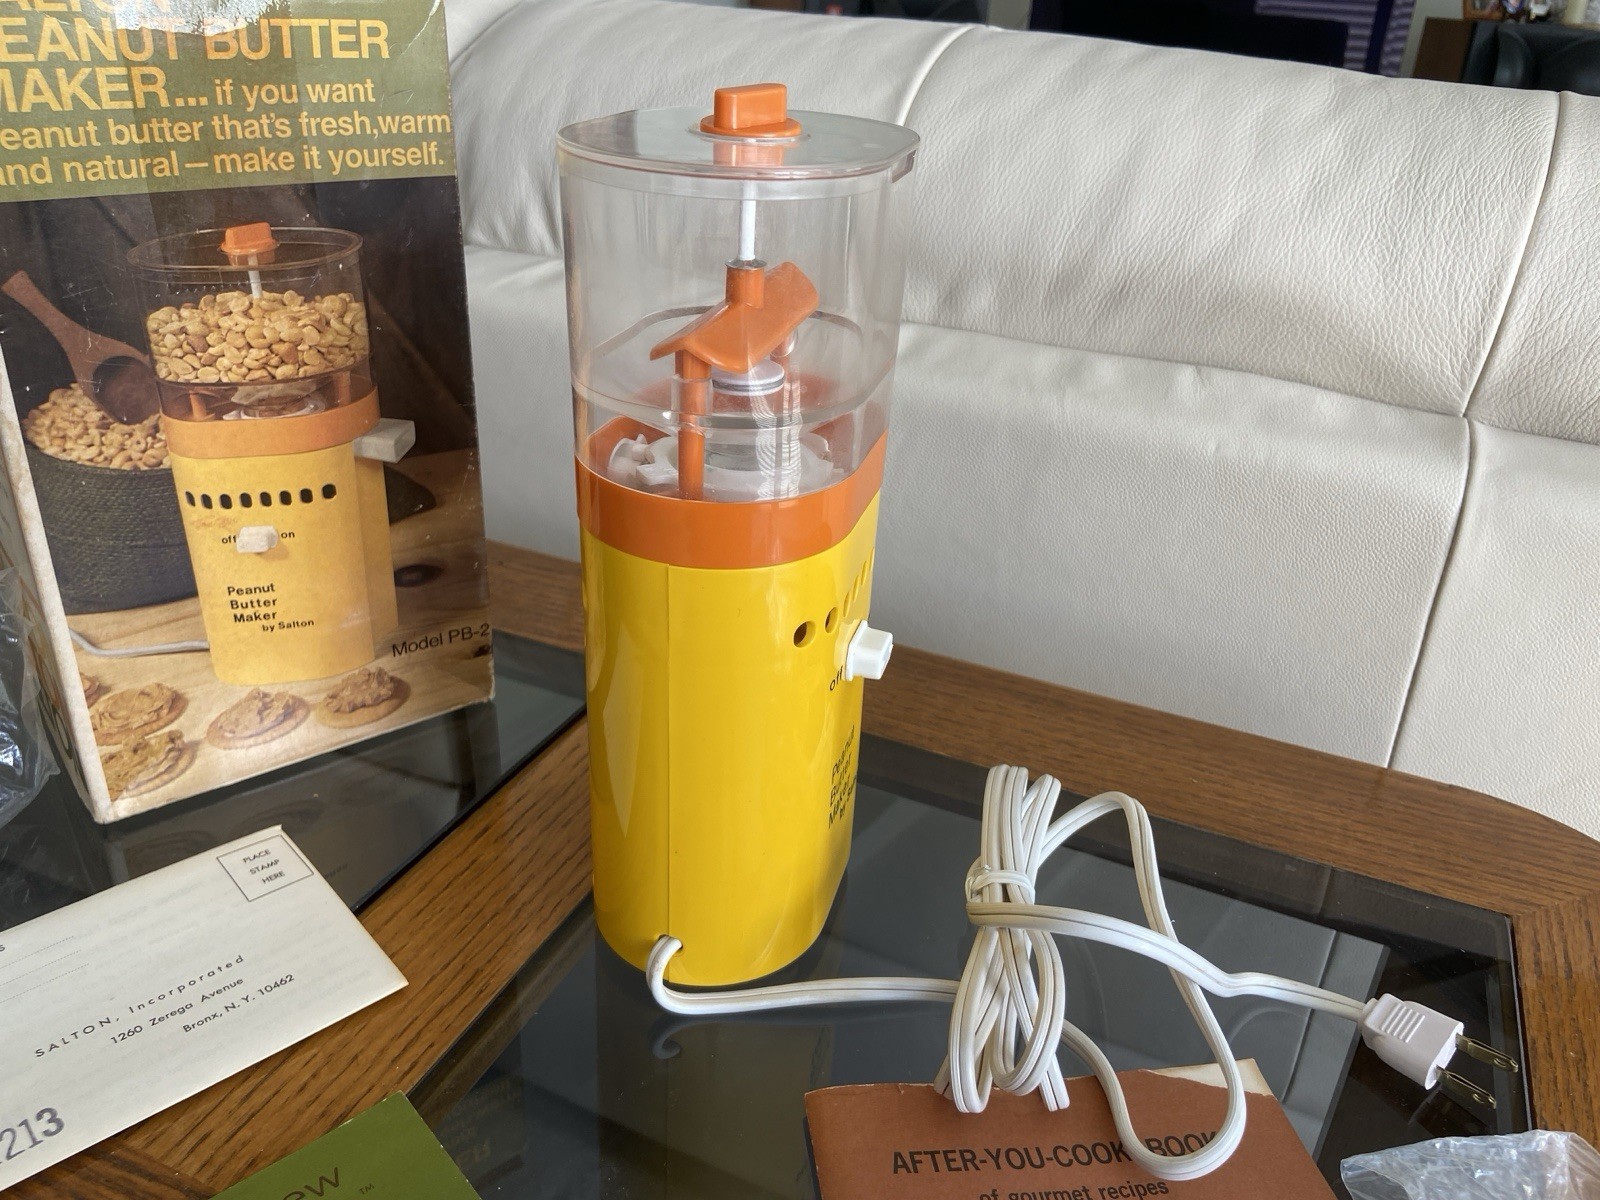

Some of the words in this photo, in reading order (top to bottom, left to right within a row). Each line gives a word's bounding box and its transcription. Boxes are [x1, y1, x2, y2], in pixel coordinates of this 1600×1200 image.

[205, 18, 391, 61] BUTTER
[214, 79, 234, 106] if
[242, 83, 299, 112] you
[306, 78, 376, 103] want
[107, 115, 203, 146] butter
[212, 112, 292, 141] that's
[63, 150, 179, 183] natural
[213, 146, 295, 174] make
[303, 144, 322, 170] it
[327, 141, 444, 175] yourself.
[281, 530, 296, 539] on
[227, 583, 275, 597] Peanut
[230, 597, 278, 610] Butter
[233, 610, 277, 624] Maker
[262, 623, 275, 632] by
[278, 618, 315, 631] Salton
[392, 632, 443, 658] Model
[449, 622, 491, 645] PB-2
[829, 665, 844, 692] off
[242, 848, 271, 864] PLACE
[249, 858, 280, 875] STAMP
[261, 870, 286, 884] HERE
[34, 1015, 121, 1058] SALTON,
[129, 954, 245, 1014] Incorporated
[110, 1025, 143, 1045] 1260
[149, 1001, 194, 1028] Zerega
[200, 977, 244, 1003] Avenue
[183, 1010, 223, 1034] Bronx,
[257, 973, 295, 996] 10462
[0, 1106, 65, 1164] 213
[892, 1140, 1133, 1175] AFTER-YOU-COOK
[979, 1188, 999, 1200] of
[1008, 1186, 1089, 1200] gourmet
[1098, 1180, 1170, 1200] recipes
